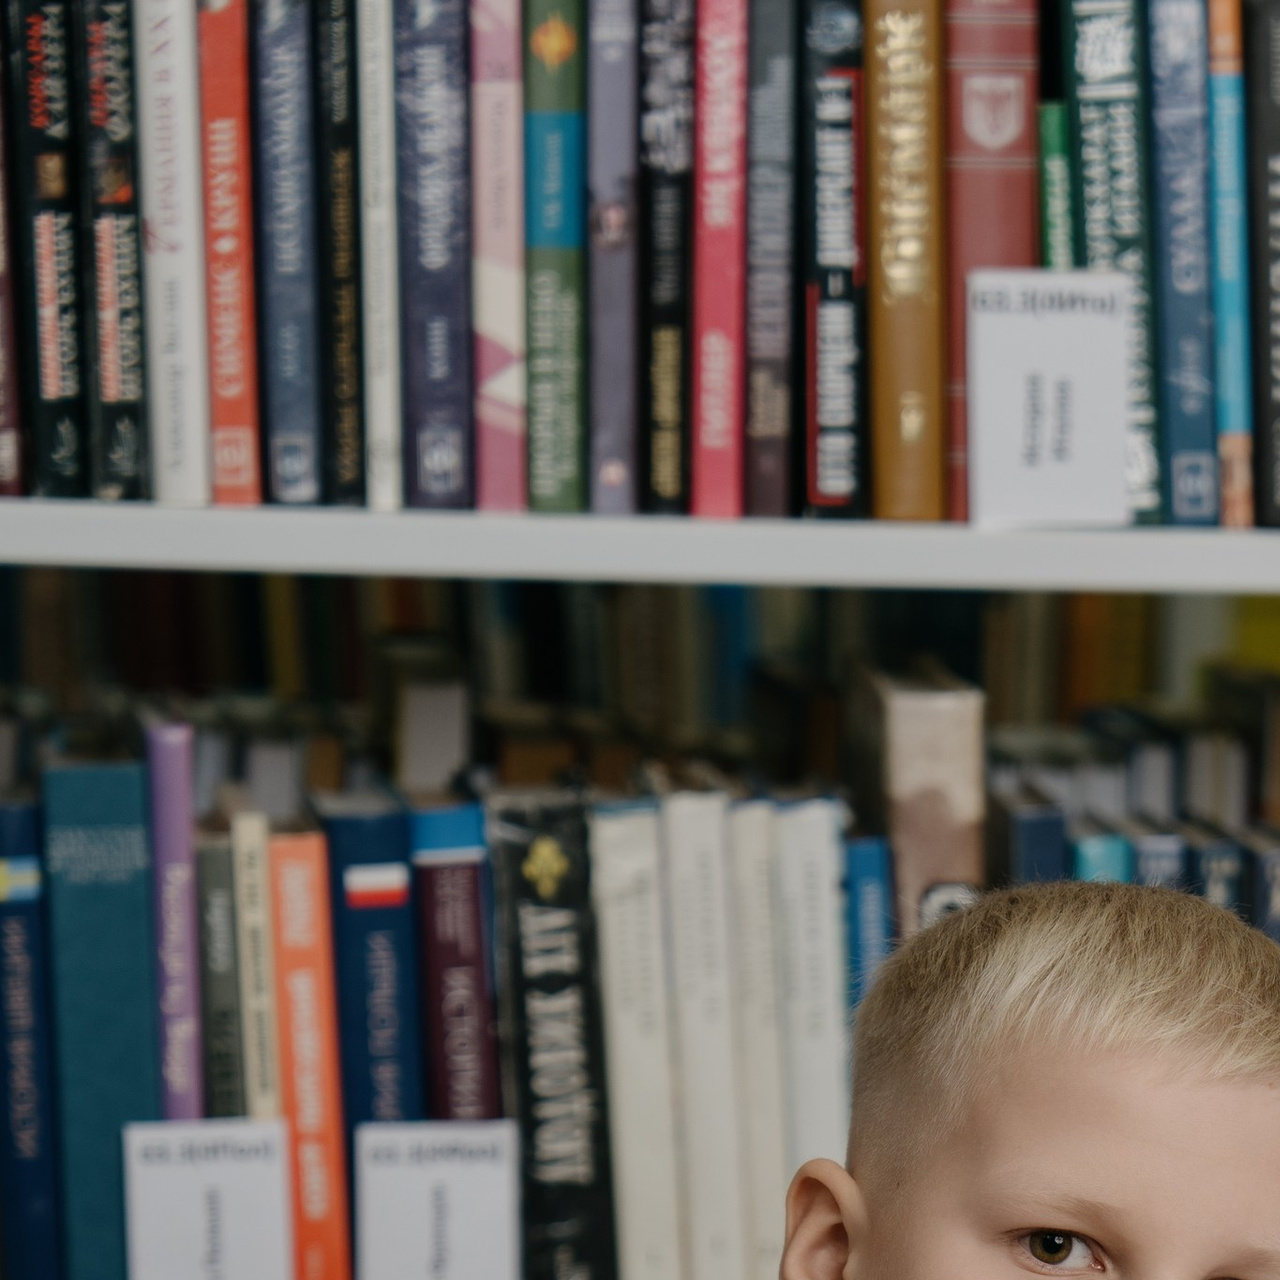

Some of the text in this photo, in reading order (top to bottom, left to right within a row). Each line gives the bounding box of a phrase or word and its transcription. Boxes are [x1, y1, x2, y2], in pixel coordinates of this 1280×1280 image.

[214, 262, 246, 400] СИМЕНС
[815, 301, 859, 427] СКОРЦЕНИ
[516, 902, 580, 980] XIV
[522, 988, 596, 1186] ЛЮДОВИК
